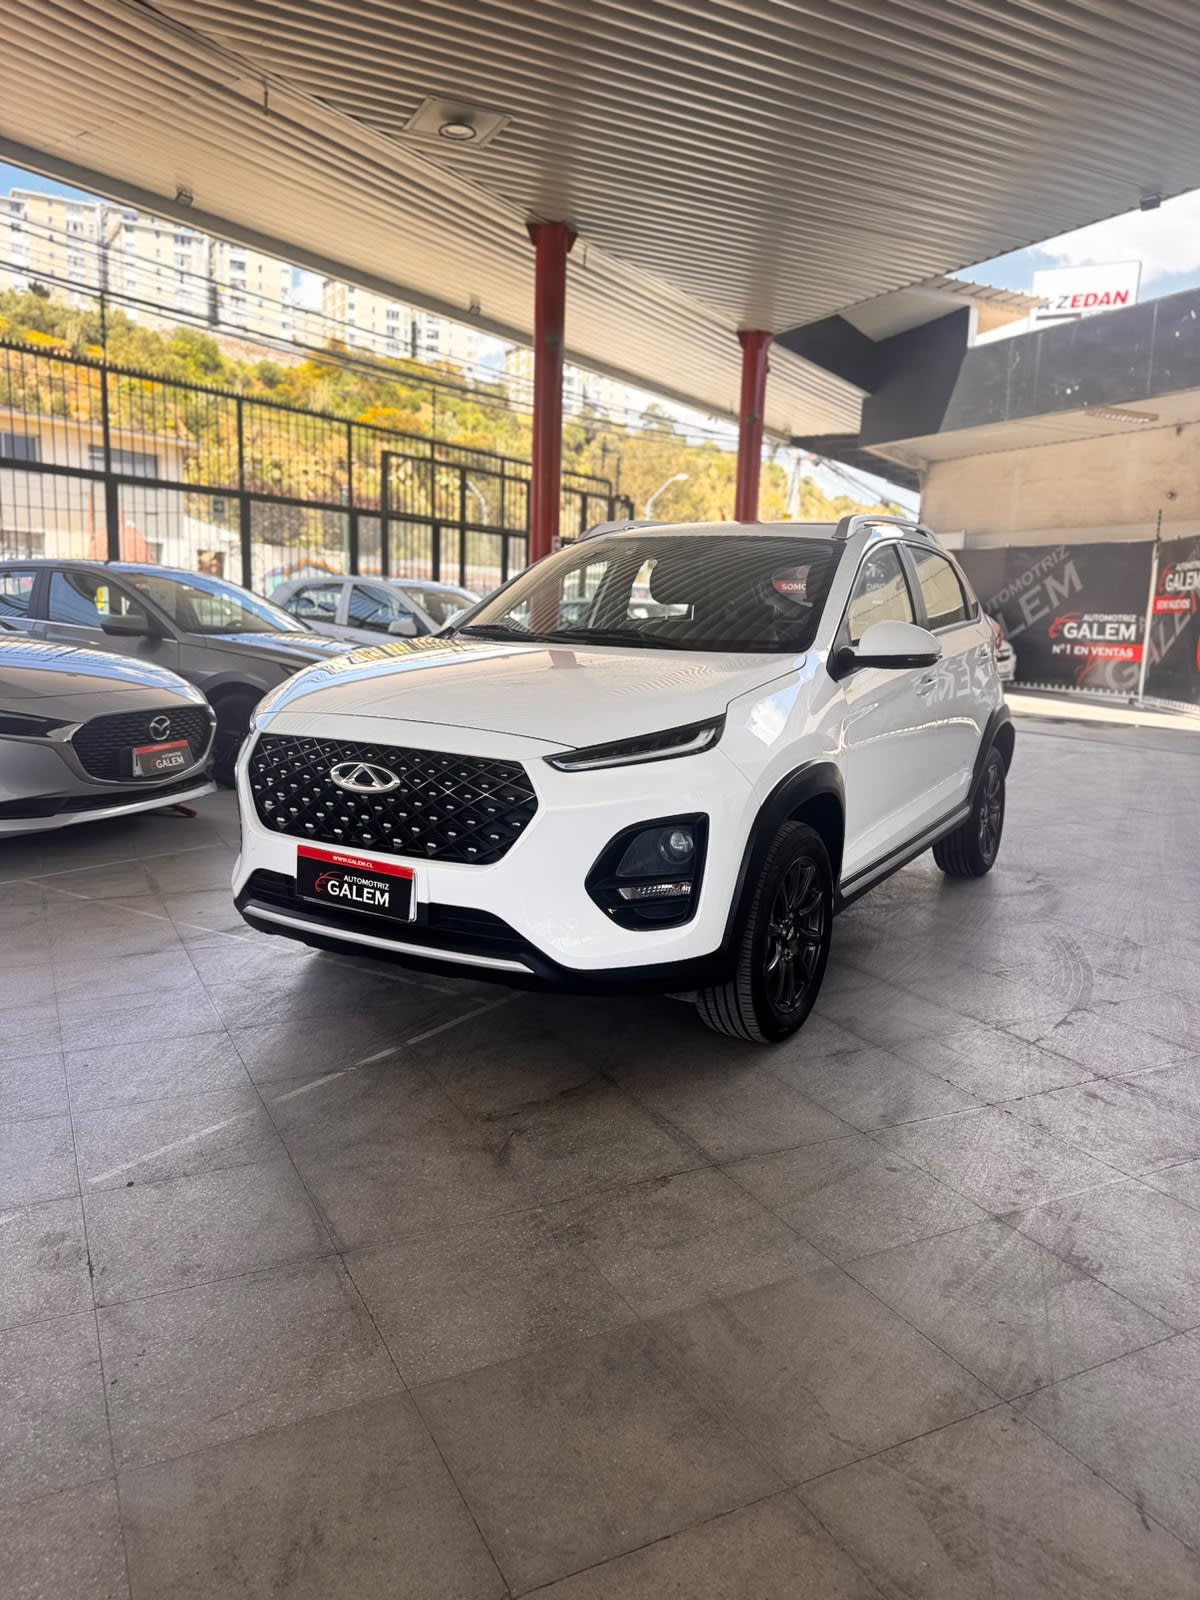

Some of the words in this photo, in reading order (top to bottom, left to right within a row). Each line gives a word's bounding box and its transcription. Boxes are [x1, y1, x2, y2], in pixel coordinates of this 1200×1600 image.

[1083, 613, 1137, 622] AUTOMOTRIZ
[1063, 622, 1137, 641] GALEM
[1074, 645, 1089, 655] EN
[1092, 646, 1134, 657] VENTAS
[155, 756, 185, 769] GALEM
[343, 874, 390, 890] AUTOMOTRIZ
[327, 880, 390, 908] GALEM
